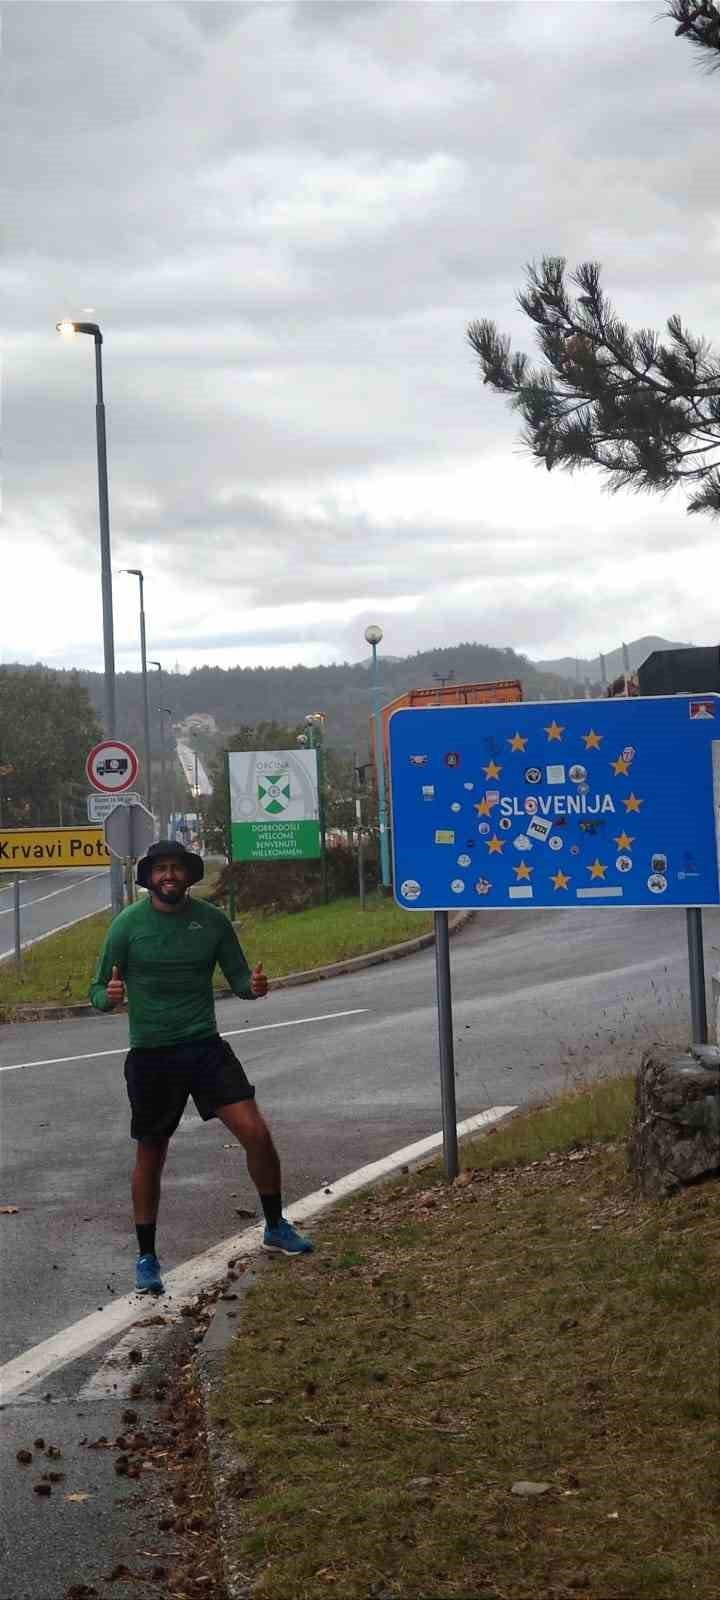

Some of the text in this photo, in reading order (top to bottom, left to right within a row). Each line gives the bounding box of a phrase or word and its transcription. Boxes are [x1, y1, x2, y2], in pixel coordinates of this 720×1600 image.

[500, 794, 615, 816] SLOVENIJA
[257, 832, 294, 840] WELCOME
[0, 840, 62, 859] Krvavi
